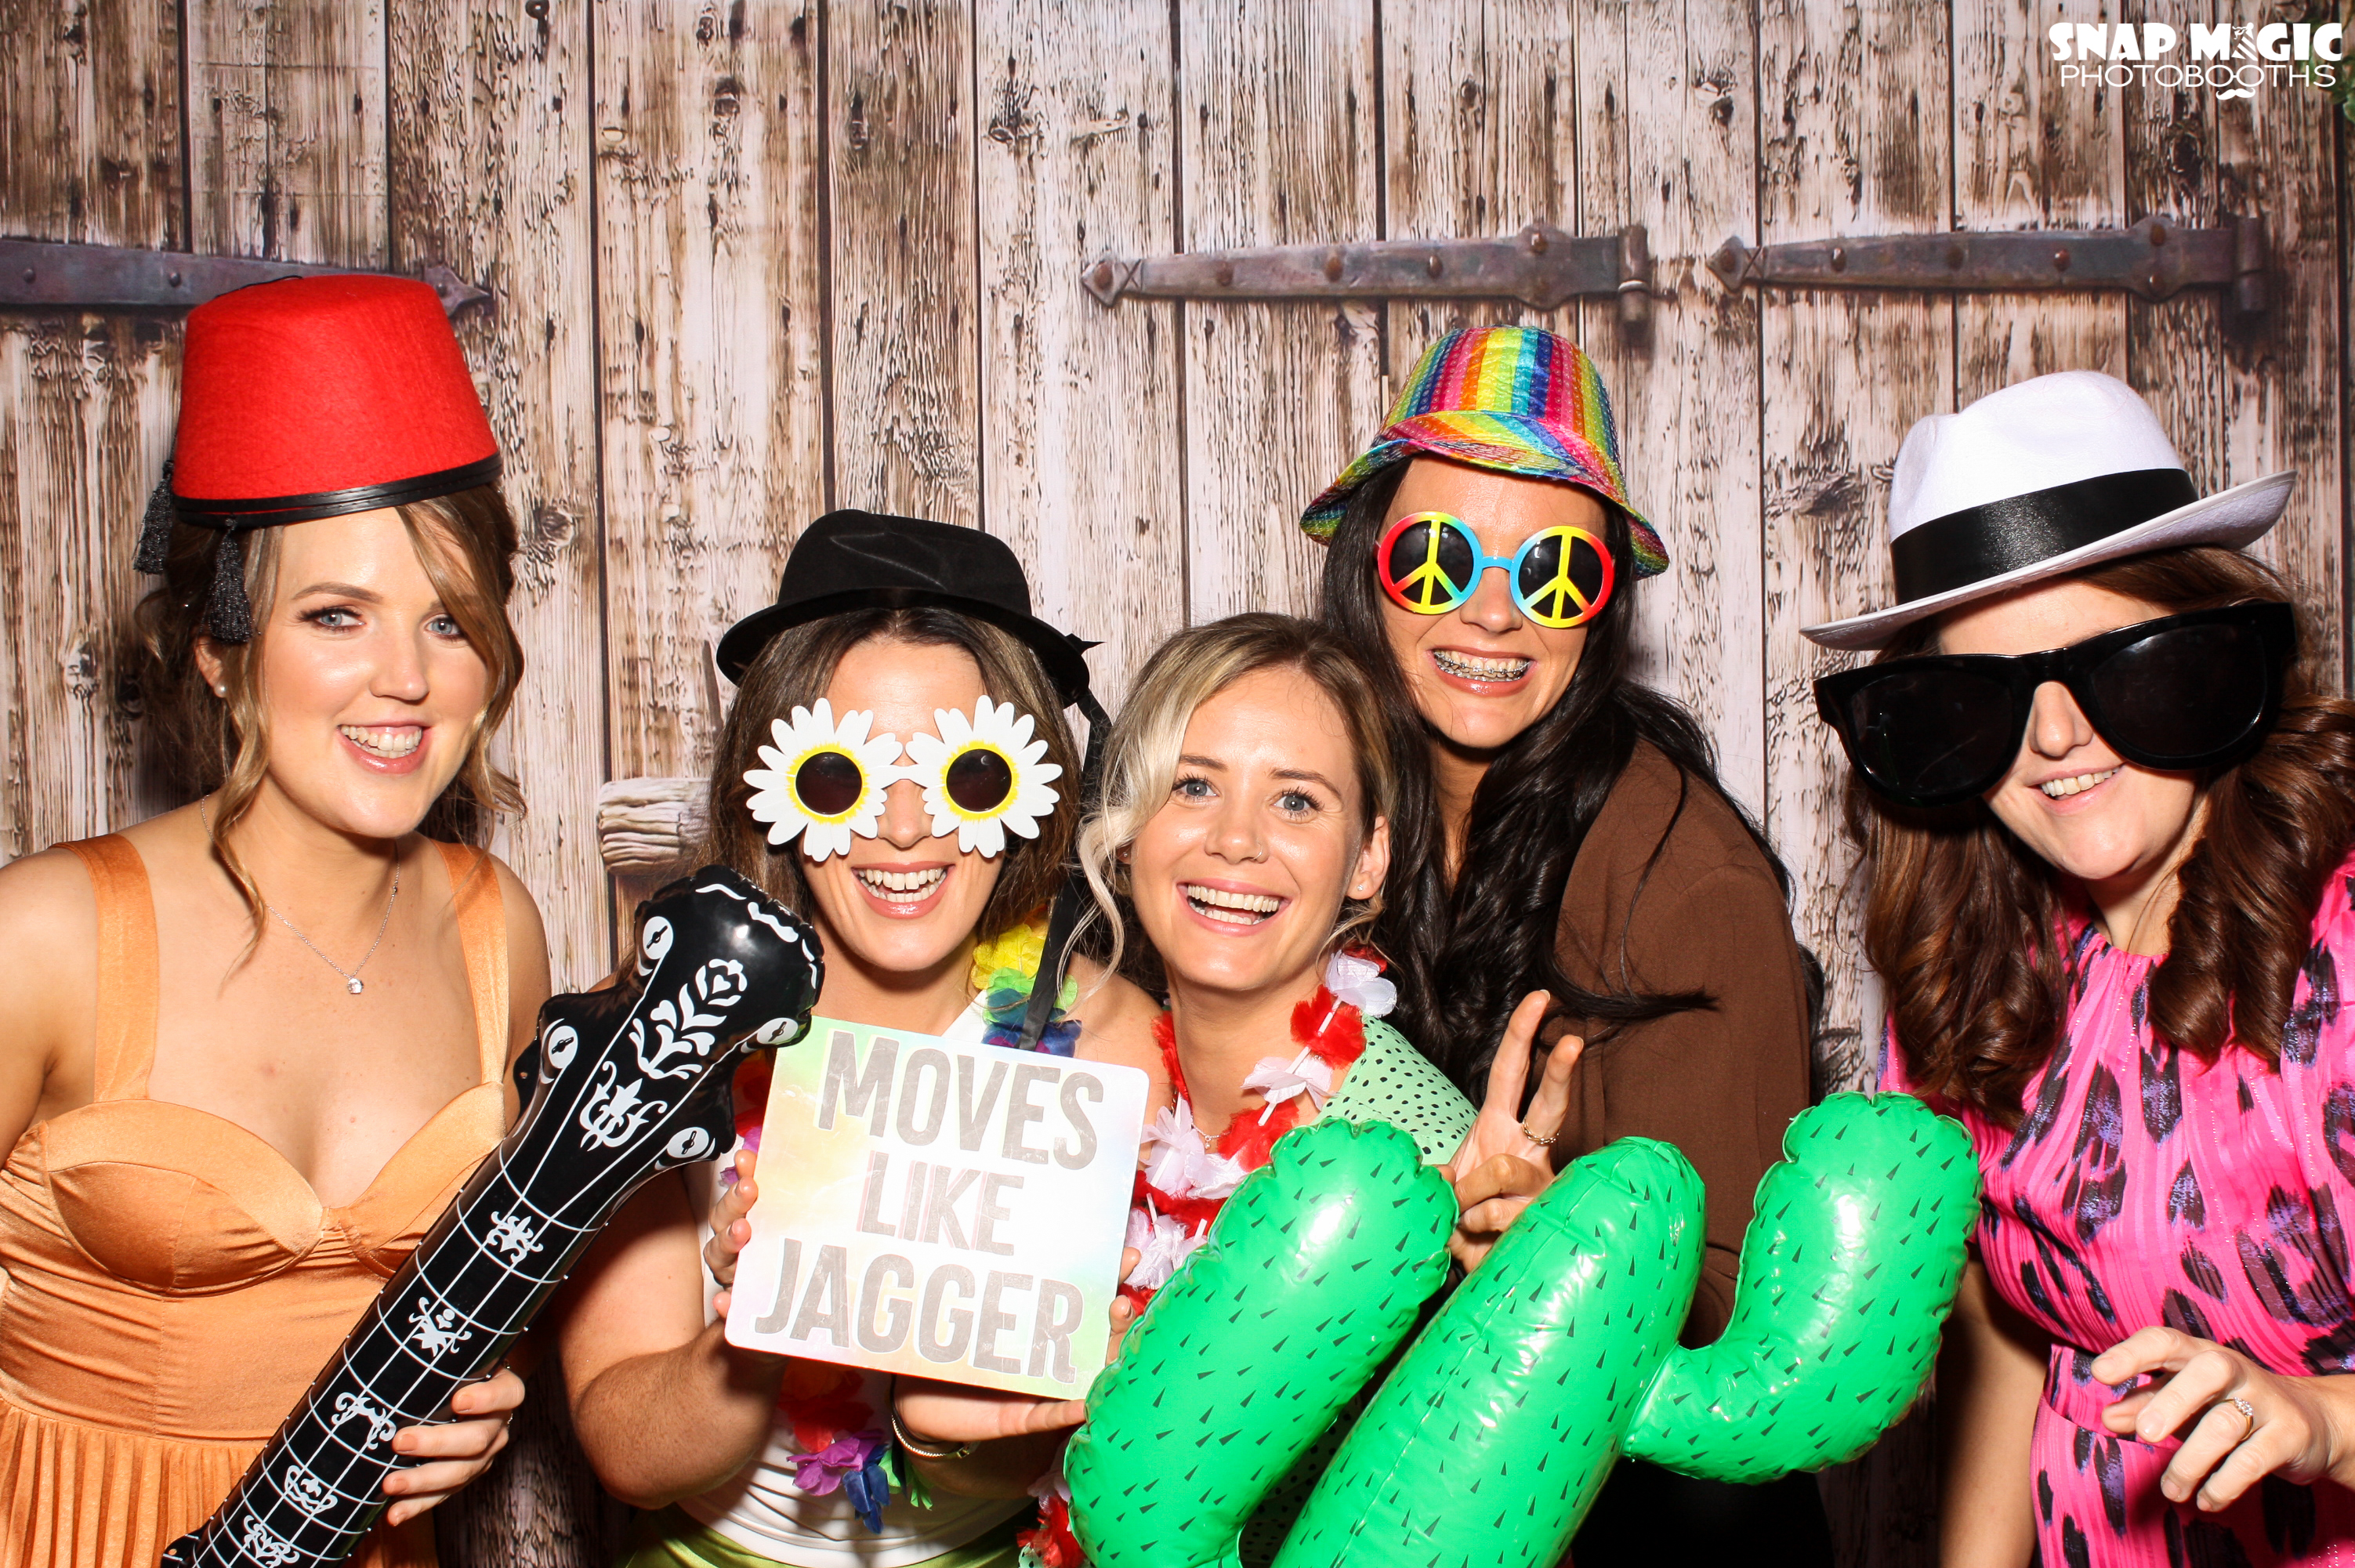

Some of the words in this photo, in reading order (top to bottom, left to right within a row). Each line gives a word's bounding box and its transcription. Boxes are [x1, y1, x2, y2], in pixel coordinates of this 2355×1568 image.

[817, 1030, 1104, 1171] MOVES
[858, 1150, 1025, 1256] LIKE
[753, 1237, 1084, 1385] JAGGER
